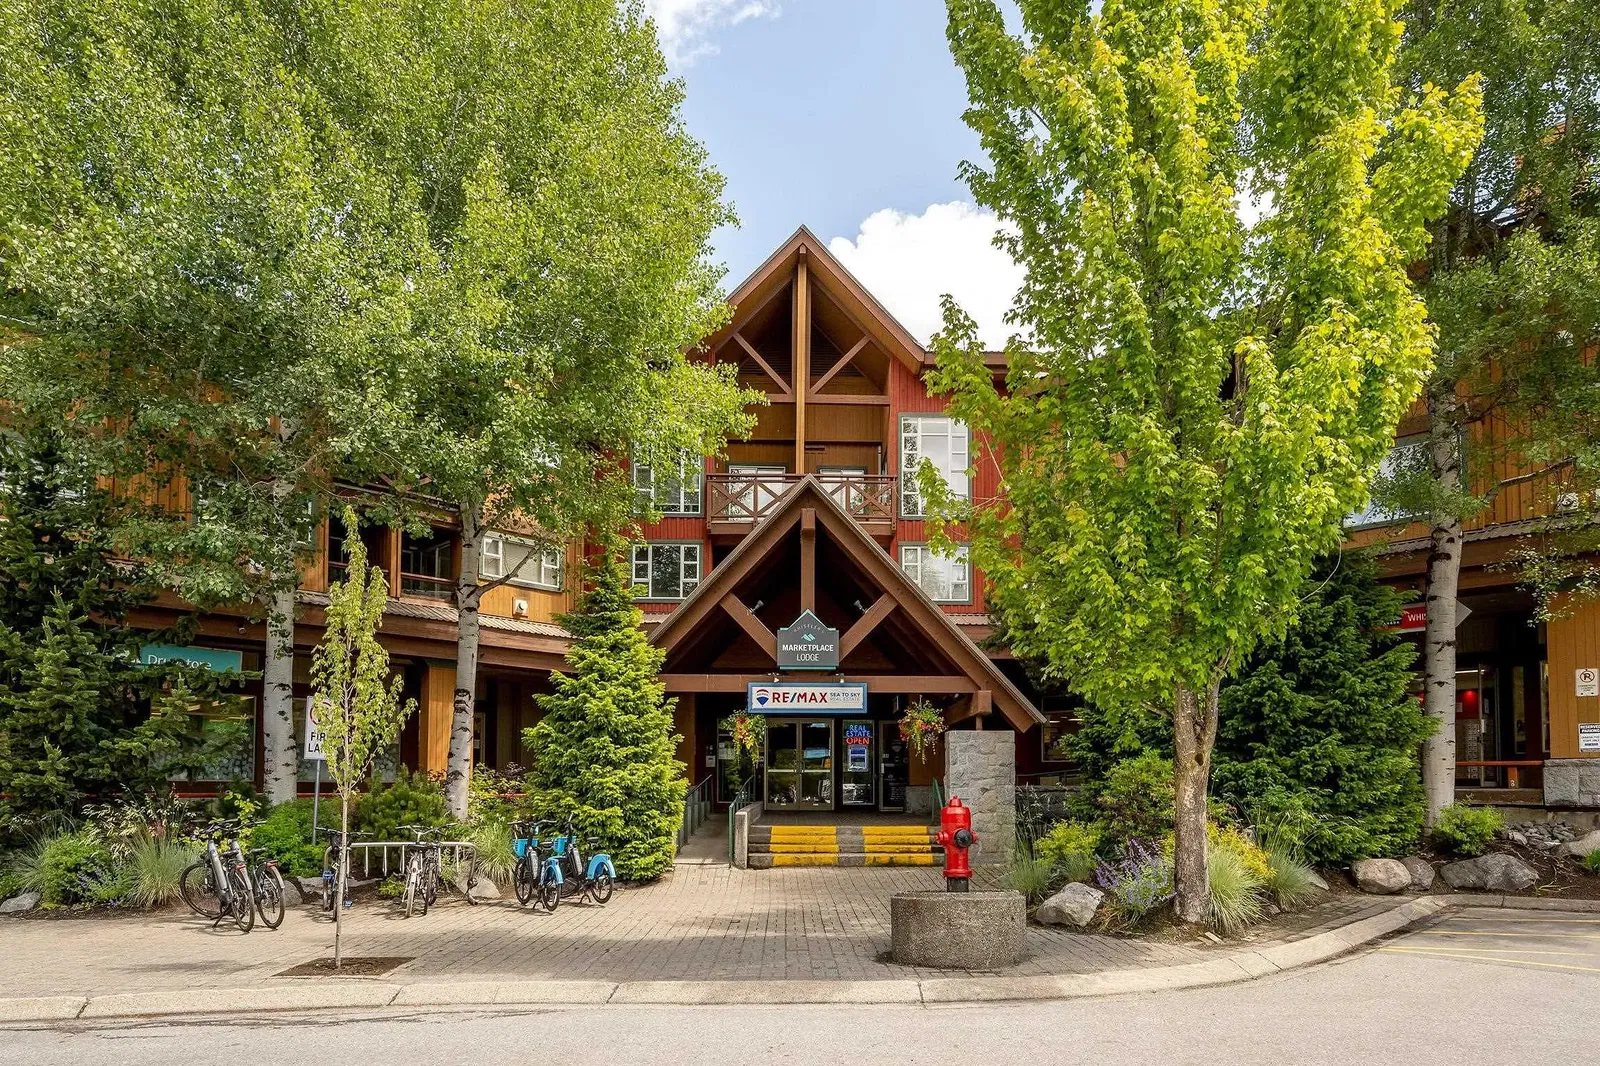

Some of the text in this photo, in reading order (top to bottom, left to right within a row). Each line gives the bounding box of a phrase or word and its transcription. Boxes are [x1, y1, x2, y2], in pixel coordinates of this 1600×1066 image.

[782, 644, 834, 652] MARKETPLACE
[796, 653, 820, 662] LODGE
[148, 654, 212, 671] Drtore
[772, 692, 828, 703] RE/MAX
[310, 732, 328, 742] FIR
[846, 730, 871, 738] ESTATE
[846, 737, 870, 745] OPEN
[308, 743, 323, 753] LA
